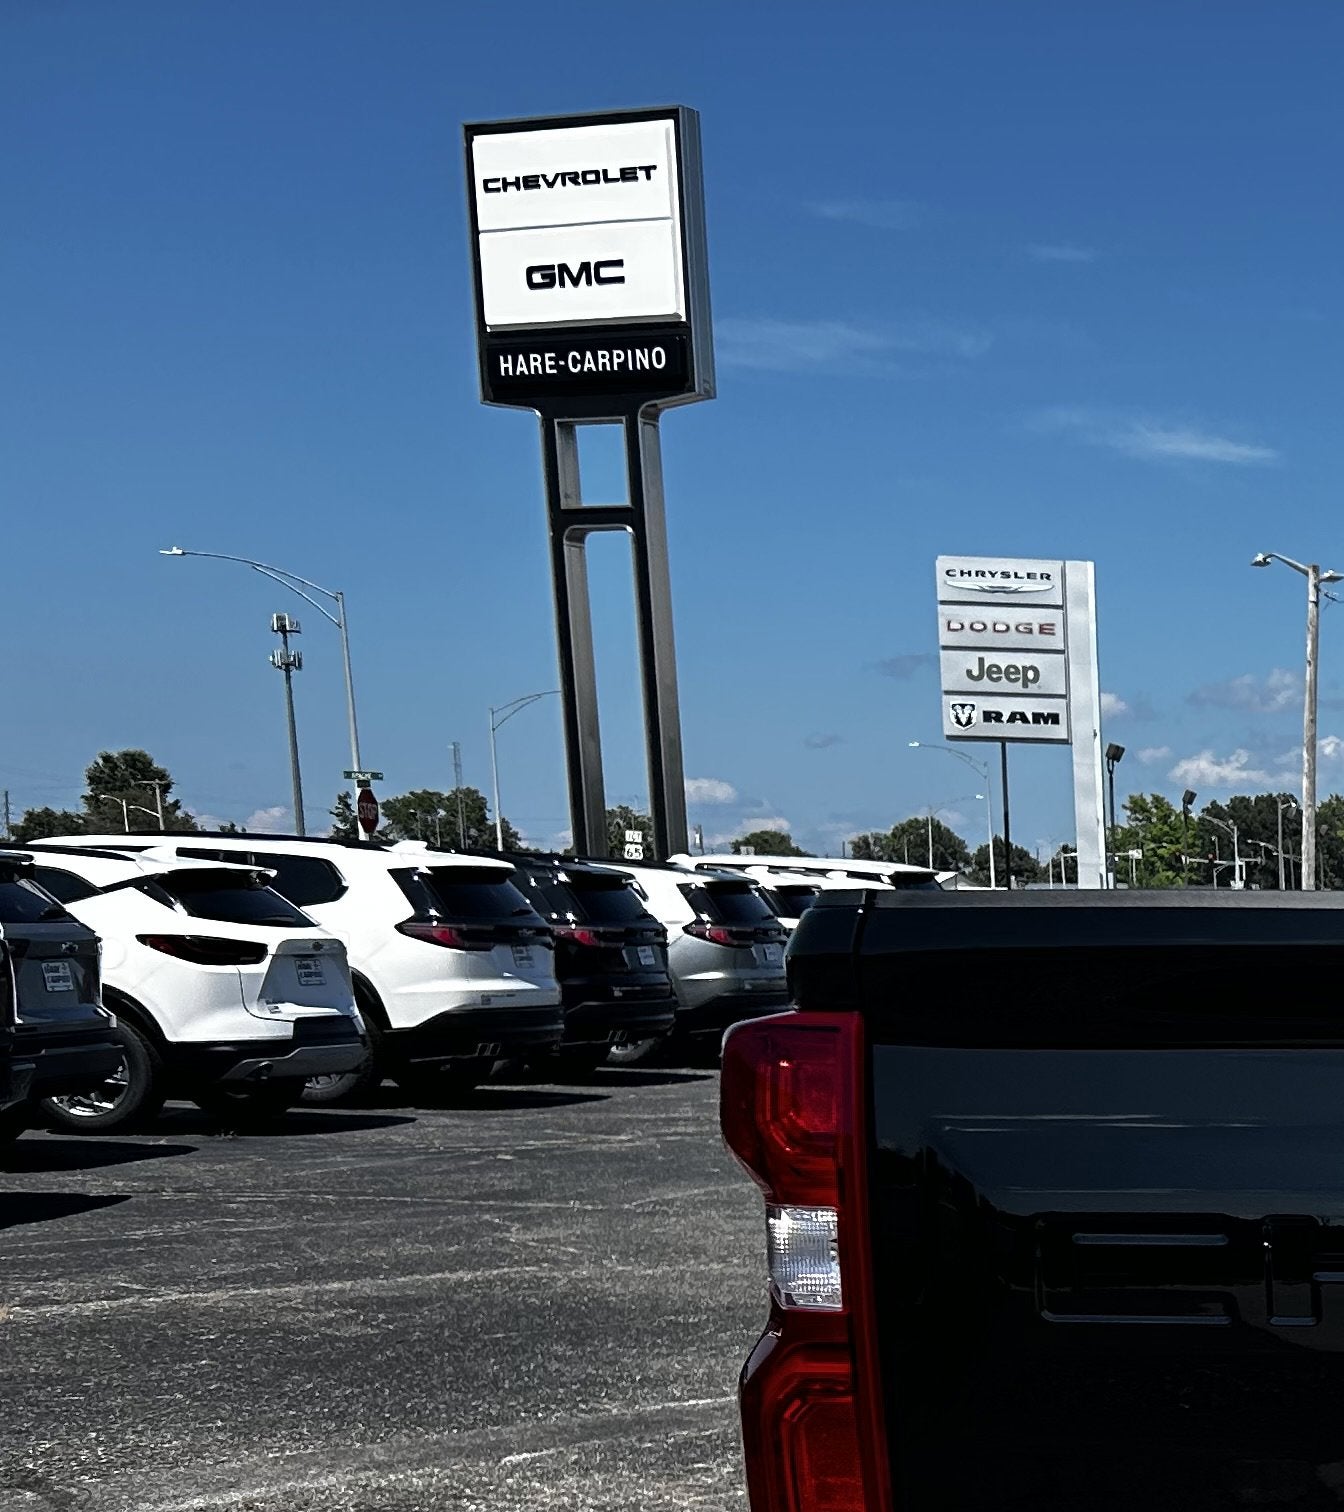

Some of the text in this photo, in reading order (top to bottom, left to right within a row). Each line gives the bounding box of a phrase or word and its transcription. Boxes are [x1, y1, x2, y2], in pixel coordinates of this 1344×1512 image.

[482, 164, 657, 193] CHEVROLET
[525, 259, 626, 291] GMC
[499, 346, 667, 377] HARE-CARPINO
[945, 568, 1052, 581] CHRYSLER
[946, 620, 1056, 636] DODGE
[965, 656, 1041, 689] Jeep
[982, 709, 1060, 726] RAM
[359, 802, 377, 819] STOP
[626, 847, 641, 858] 65
